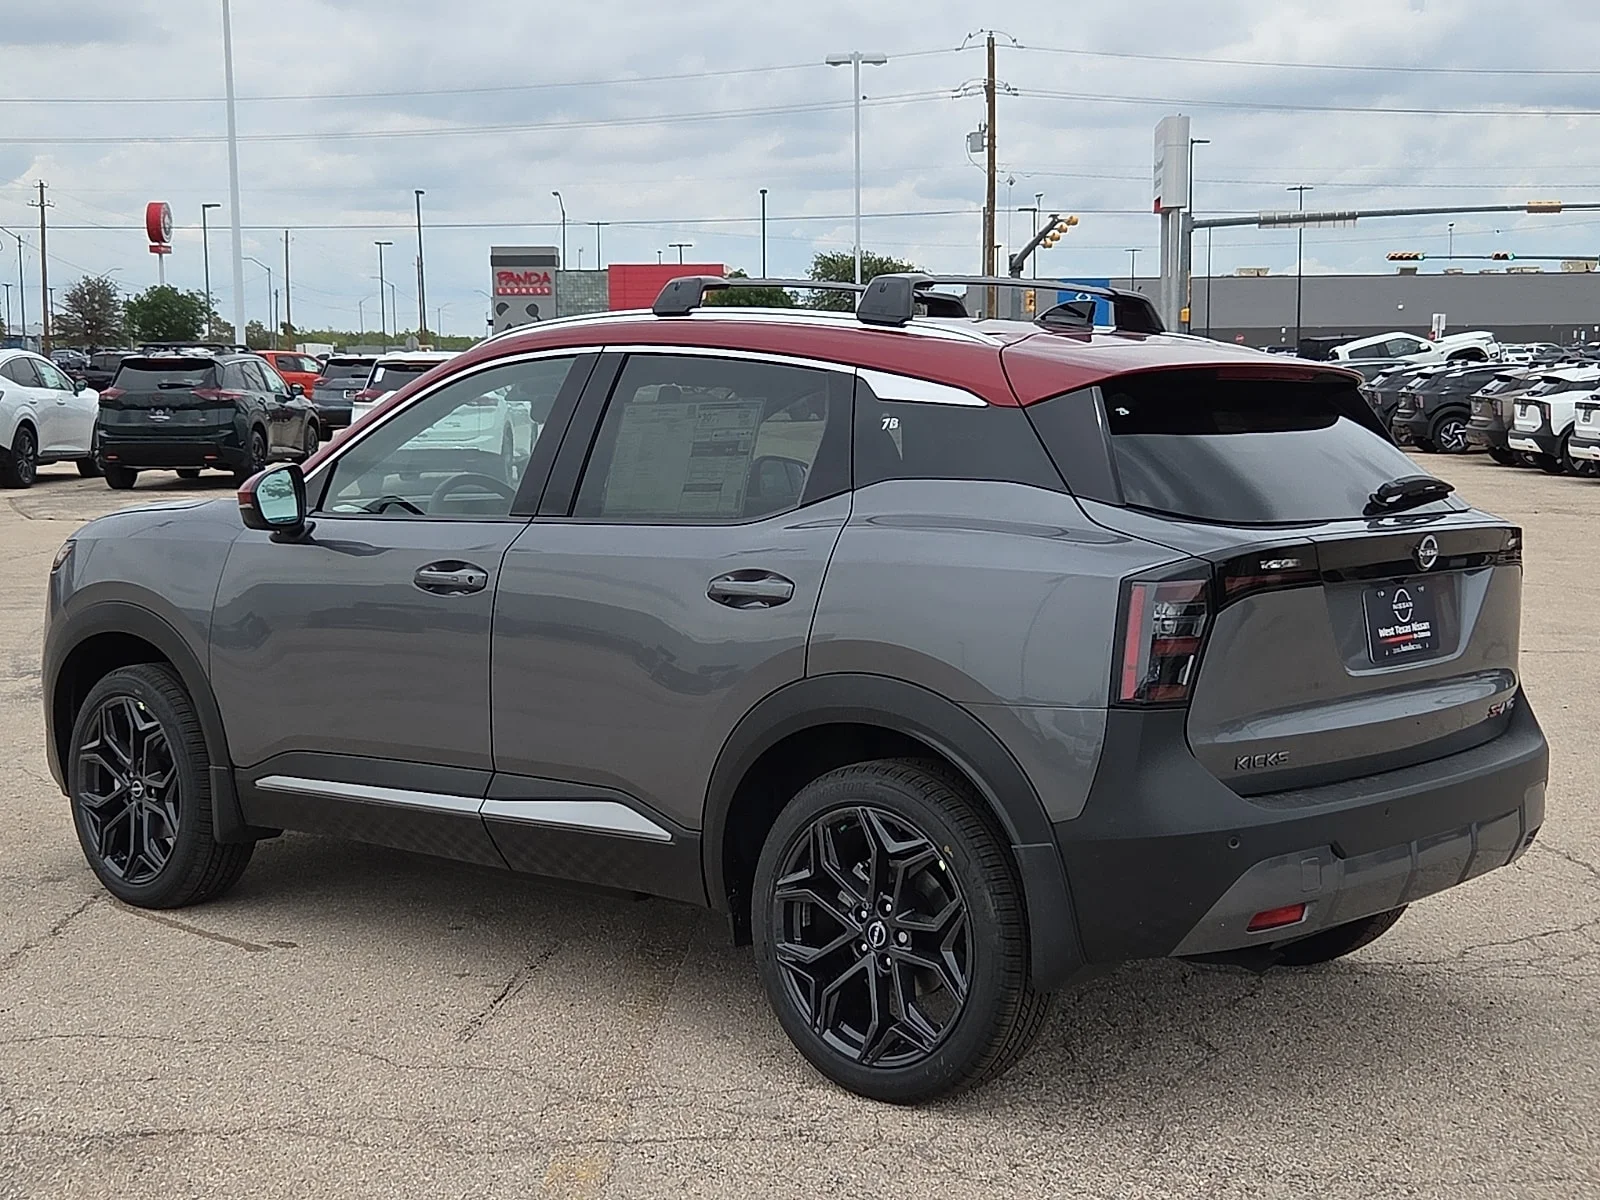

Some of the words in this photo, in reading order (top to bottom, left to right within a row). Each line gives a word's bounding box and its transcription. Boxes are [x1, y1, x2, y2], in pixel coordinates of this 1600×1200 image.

[496, 270, 552, 286] PANDA
[1392, 602, 1413, 610] NISSAN
[1378, 627, 1395, 638] West
[1394, 624, 1412, 635] Texas
[1411, 621, 1430, 632] Nissan
[1234, 750, 1290, 770] KICKS
